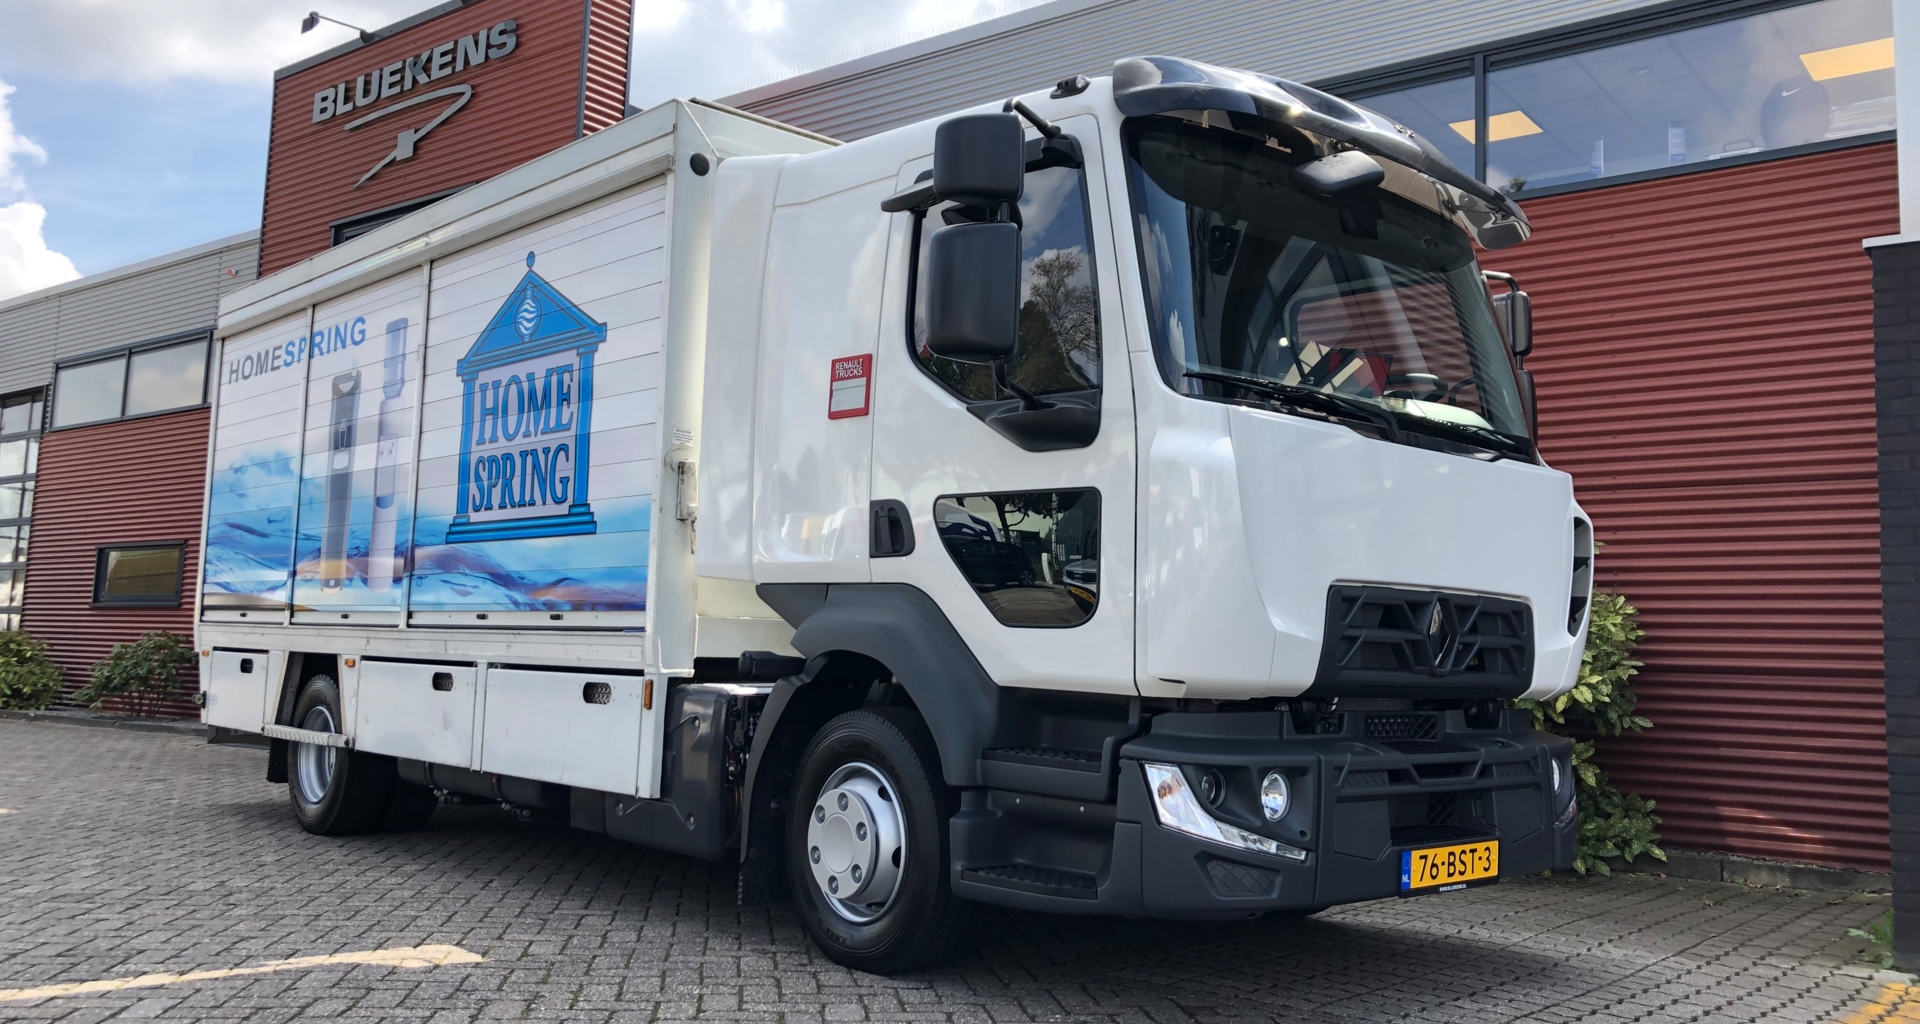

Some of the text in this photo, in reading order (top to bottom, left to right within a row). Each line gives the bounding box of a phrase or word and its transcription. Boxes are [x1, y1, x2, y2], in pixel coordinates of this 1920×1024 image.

[312, 19, 517, 124] BLUEKENS
[228, 316, 367, 386] HOMESPRING
[835, 358, 864, 371] RENAULT
[835, 367, 863, 379] TRUCKS
[476, 363, 574, 446] HOME
[472, 443, 570, 512] SPRING
[1402, 874, 1410, 883] NL
[1418, 846, 1492, 882] 76-BST-3
